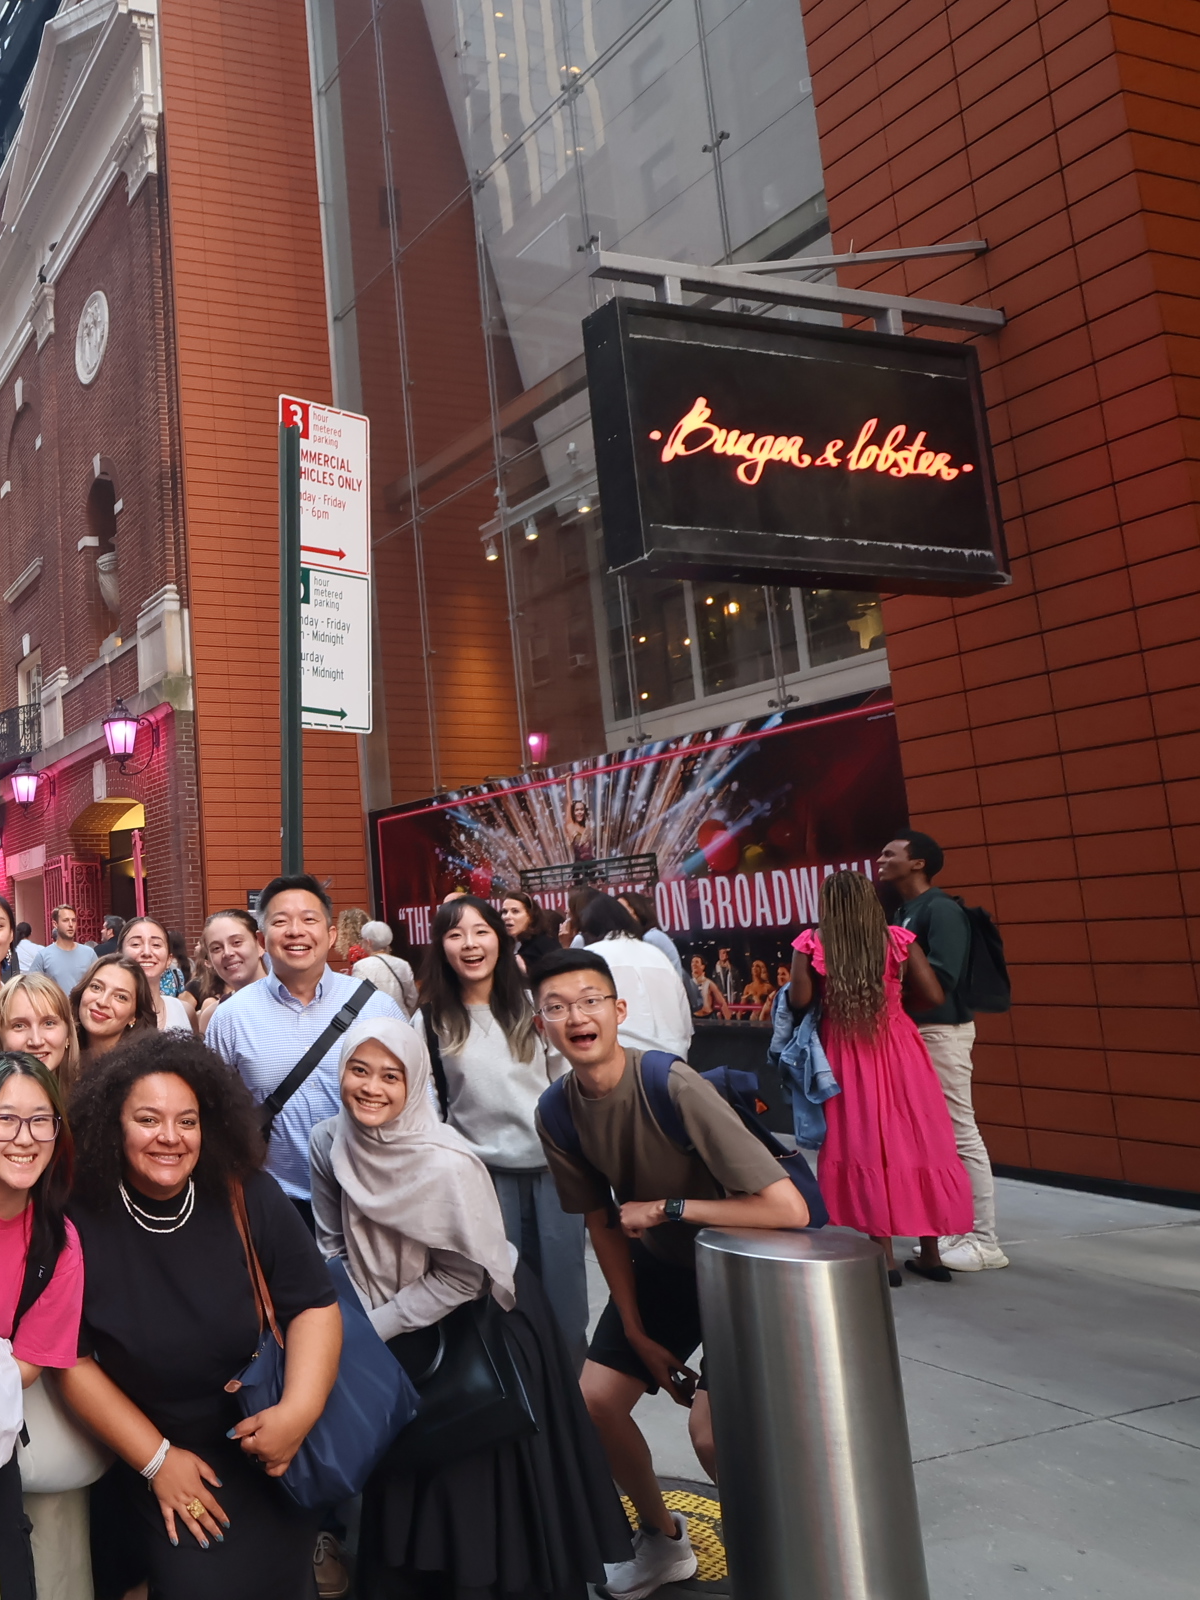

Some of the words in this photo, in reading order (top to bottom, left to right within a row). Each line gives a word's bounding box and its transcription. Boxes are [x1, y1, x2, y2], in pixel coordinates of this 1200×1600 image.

[289, 404, 303, 434] 3
[313, 411, 329, 423] hour
[313, 423, 342, 438] metered
[313, 434, 339, 449] parking
[300, 448, 352, 473] MMERCIAL
[815, 439, 843, 468] &
[300, 466, 334, 487] HICLES
[338, 475, 362, 492] ONLY
[300, 490, 316, 505] nday
[323, 494, 346, 511] Friday
[311, 506, 330, 520] 6pm
[313, 576, 329, 588] hour
[313, 587, 343, 600] metered
[313, 598, 340, 611] parking
[300, 615, 319, 629] nday
[326, 618, 351, 634] Friday
[312, 630, 344, 646] Midnight
[301, 652, 325, 665] urday
[312, 666, 344, 682] Midnight
[655, 880, 691, 932] ON
[698, 859, 873, 930] BROADW
